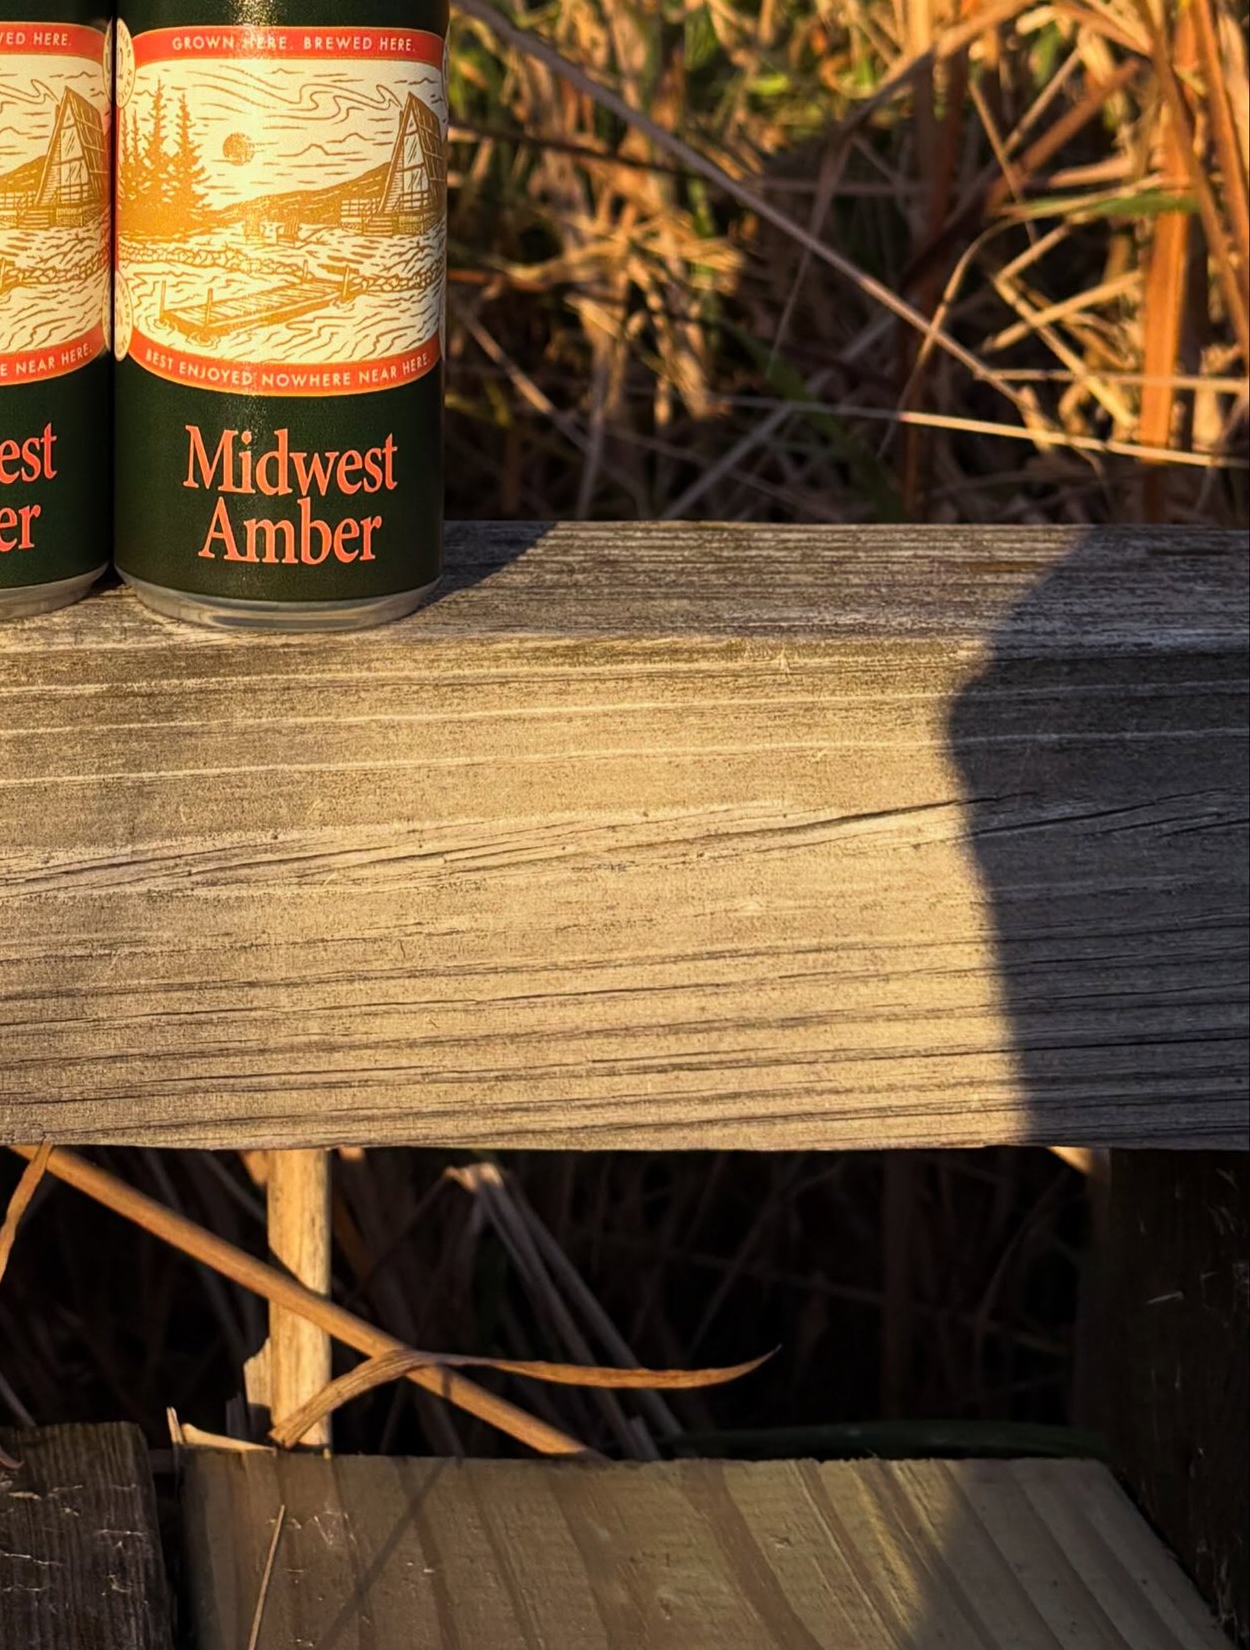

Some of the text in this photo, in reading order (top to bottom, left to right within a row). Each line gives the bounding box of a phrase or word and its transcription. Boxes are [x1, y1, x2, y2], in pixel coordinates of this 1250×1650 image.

[33, 32, 71, 46] HERE.
[172, 36, 416, 52] GROWN HERE. BREWED HERE.
[16, 353, 55, 374] NEAR
[61, 343, 93, 366] HERE.
[145, 349, 430, 387] BEST ENJOYED NOWHERE NEAR HERE.
[183, 425, 398, 496] Midwest
[198, 495, 382, 565] Amber
